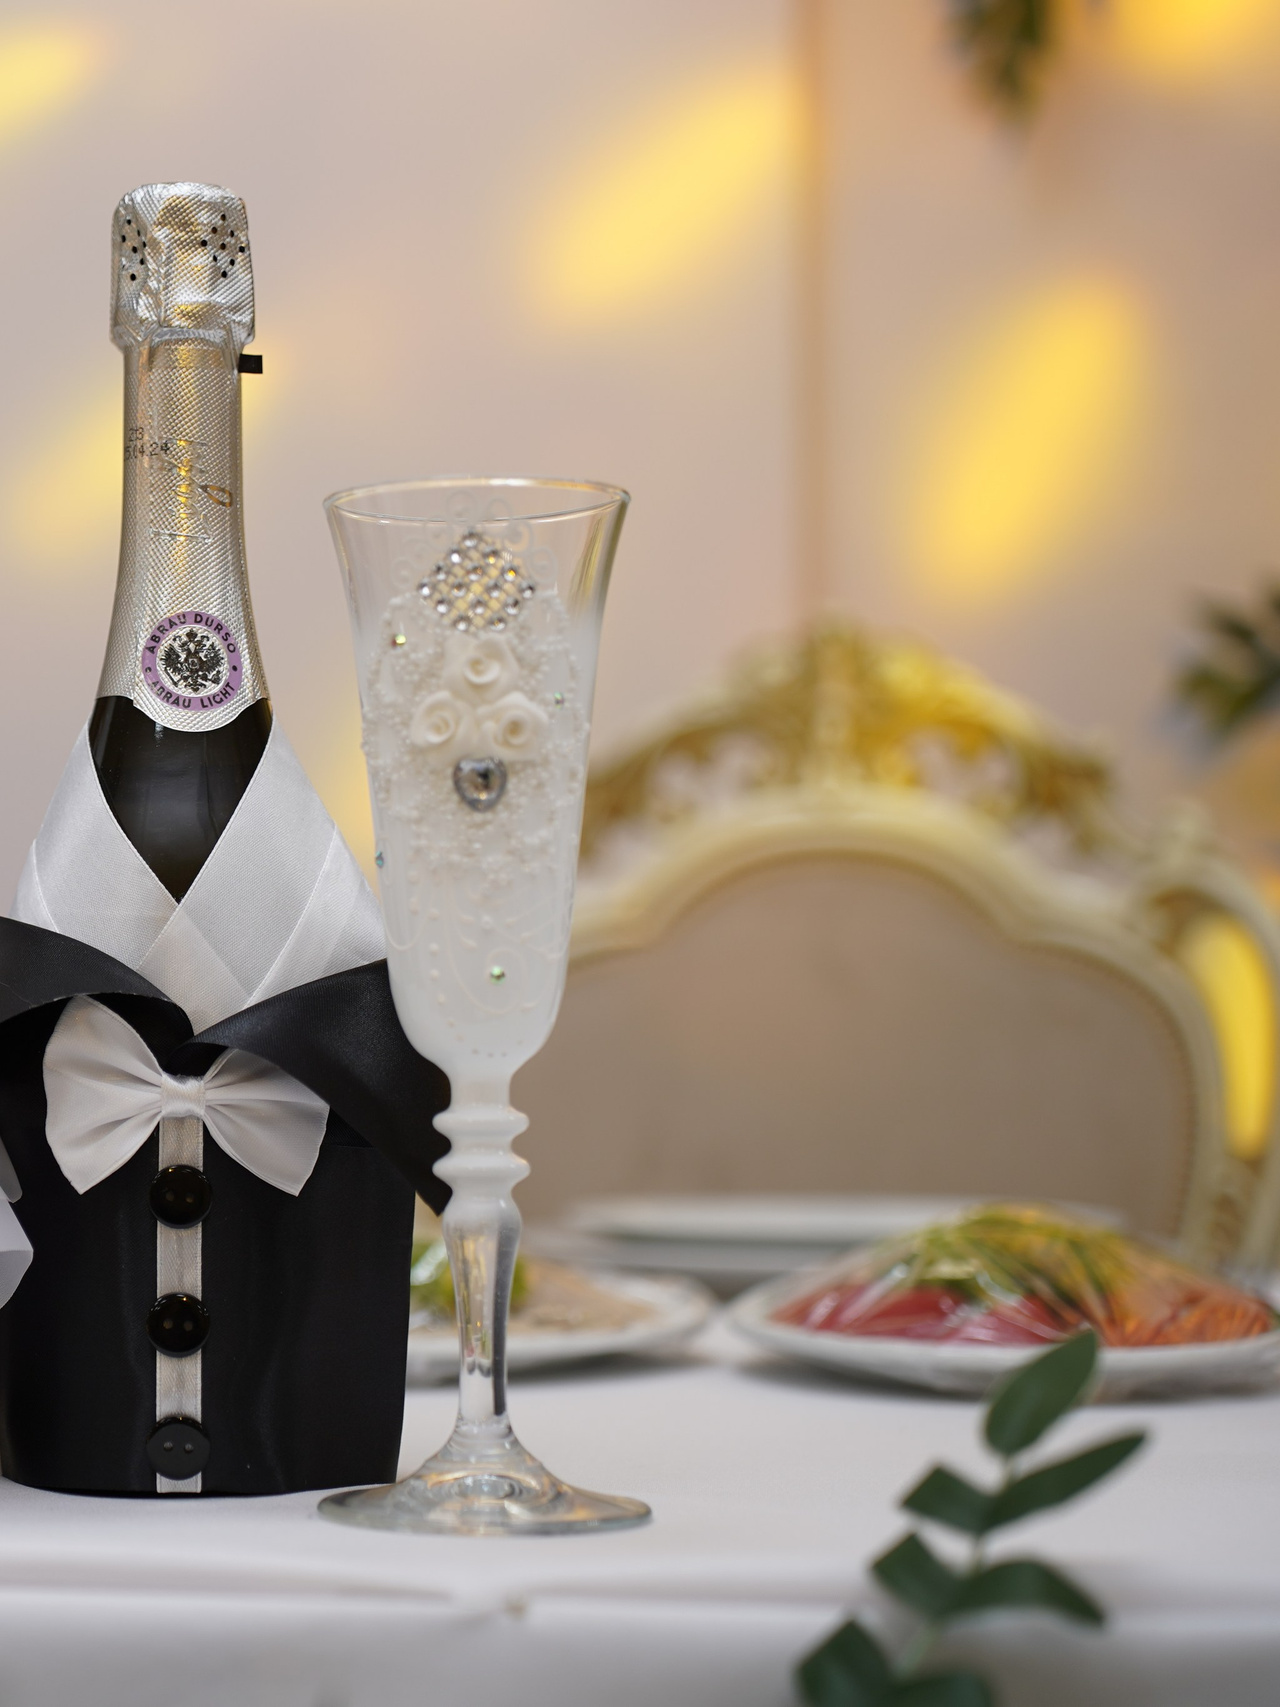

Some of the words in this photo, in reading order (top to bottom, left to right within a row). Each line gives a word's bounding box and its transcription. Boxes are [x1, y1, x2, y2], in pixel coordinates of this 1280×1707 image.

[146, 614, 187, 654] ABRAU
[194, 613, 236, 653] DURSO
[200, 681, 235, 708] LIGHT
